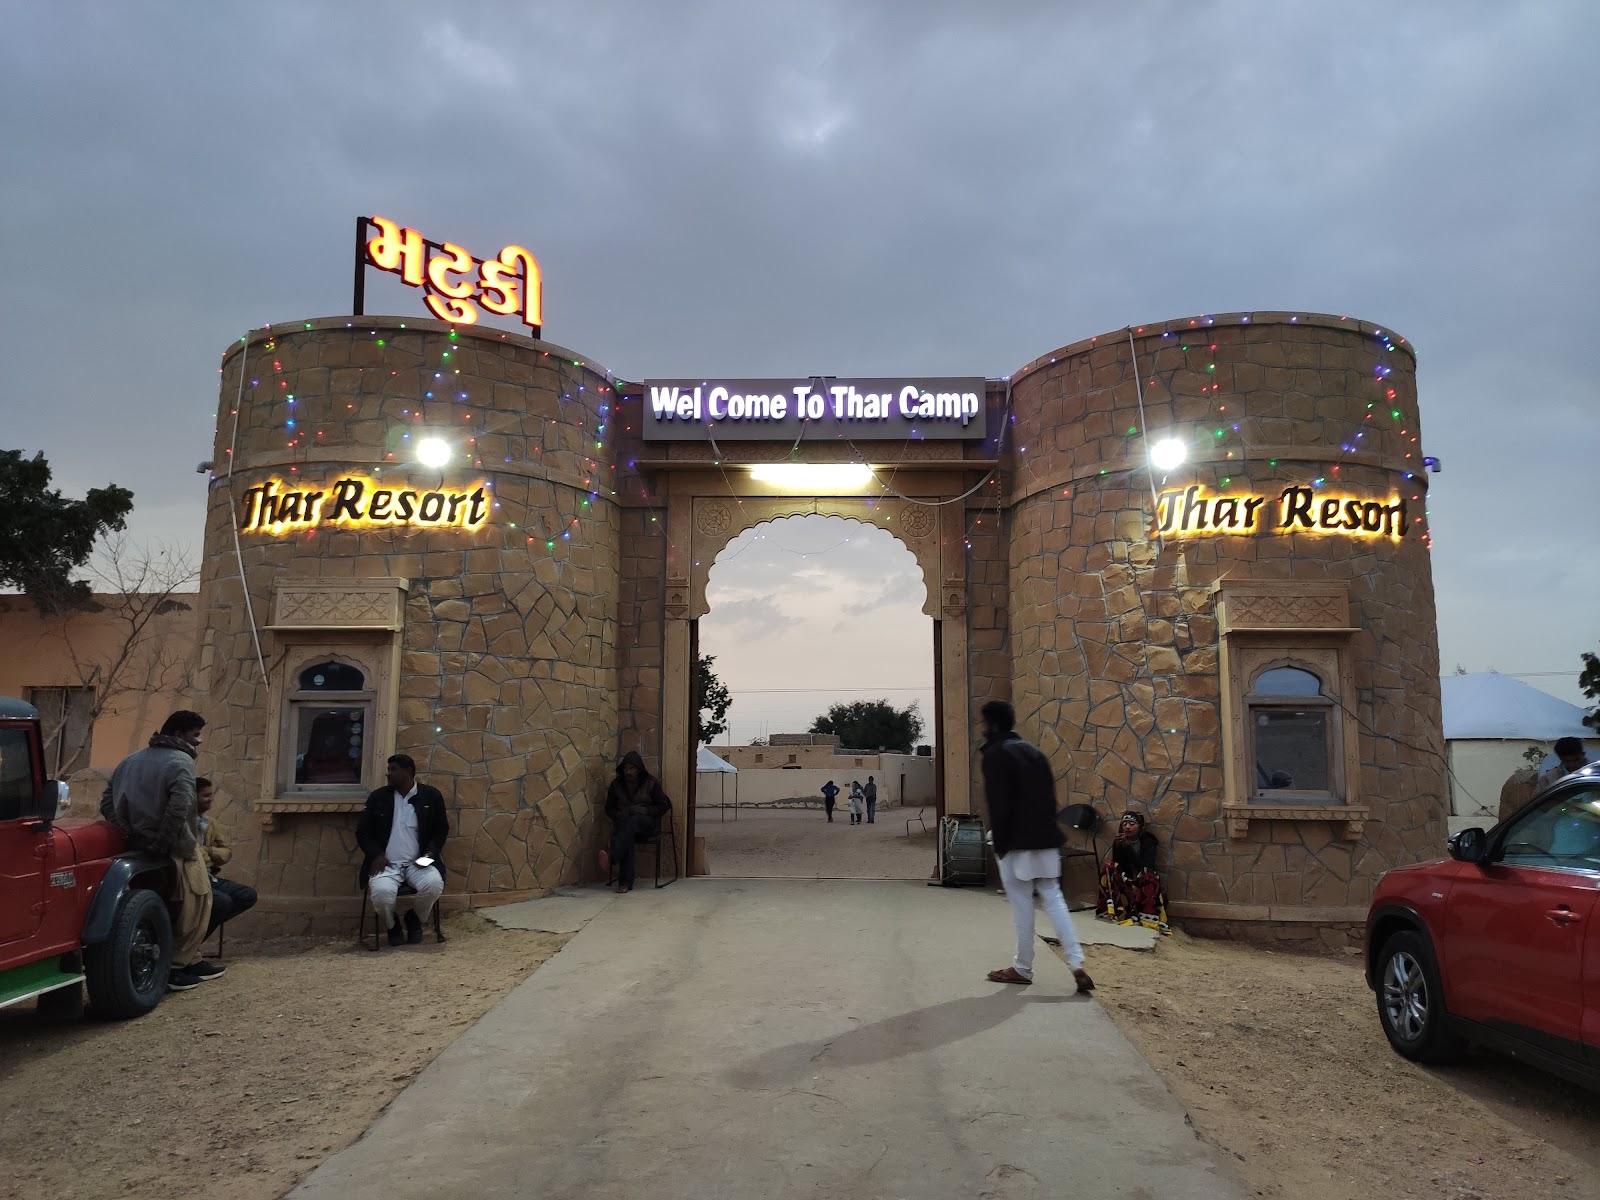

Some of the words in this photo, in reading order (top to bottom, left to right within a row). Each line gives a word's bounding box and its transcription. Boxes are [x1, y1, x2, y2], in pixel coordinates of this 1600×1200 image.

[650, 386, 701, 420] Wel
[708, 386, 787, 420] Come
[793, 386, 824, 419] To
[830, 386, 892, 419] Thar
[899, 385, 979, 426] Camp
[241, 481, 324, 529] Thar
[326, 478, 486, 525] Resort
[1156, 485, 1264, 532] Thar
[1277, 485, 1410, 536] Resort
